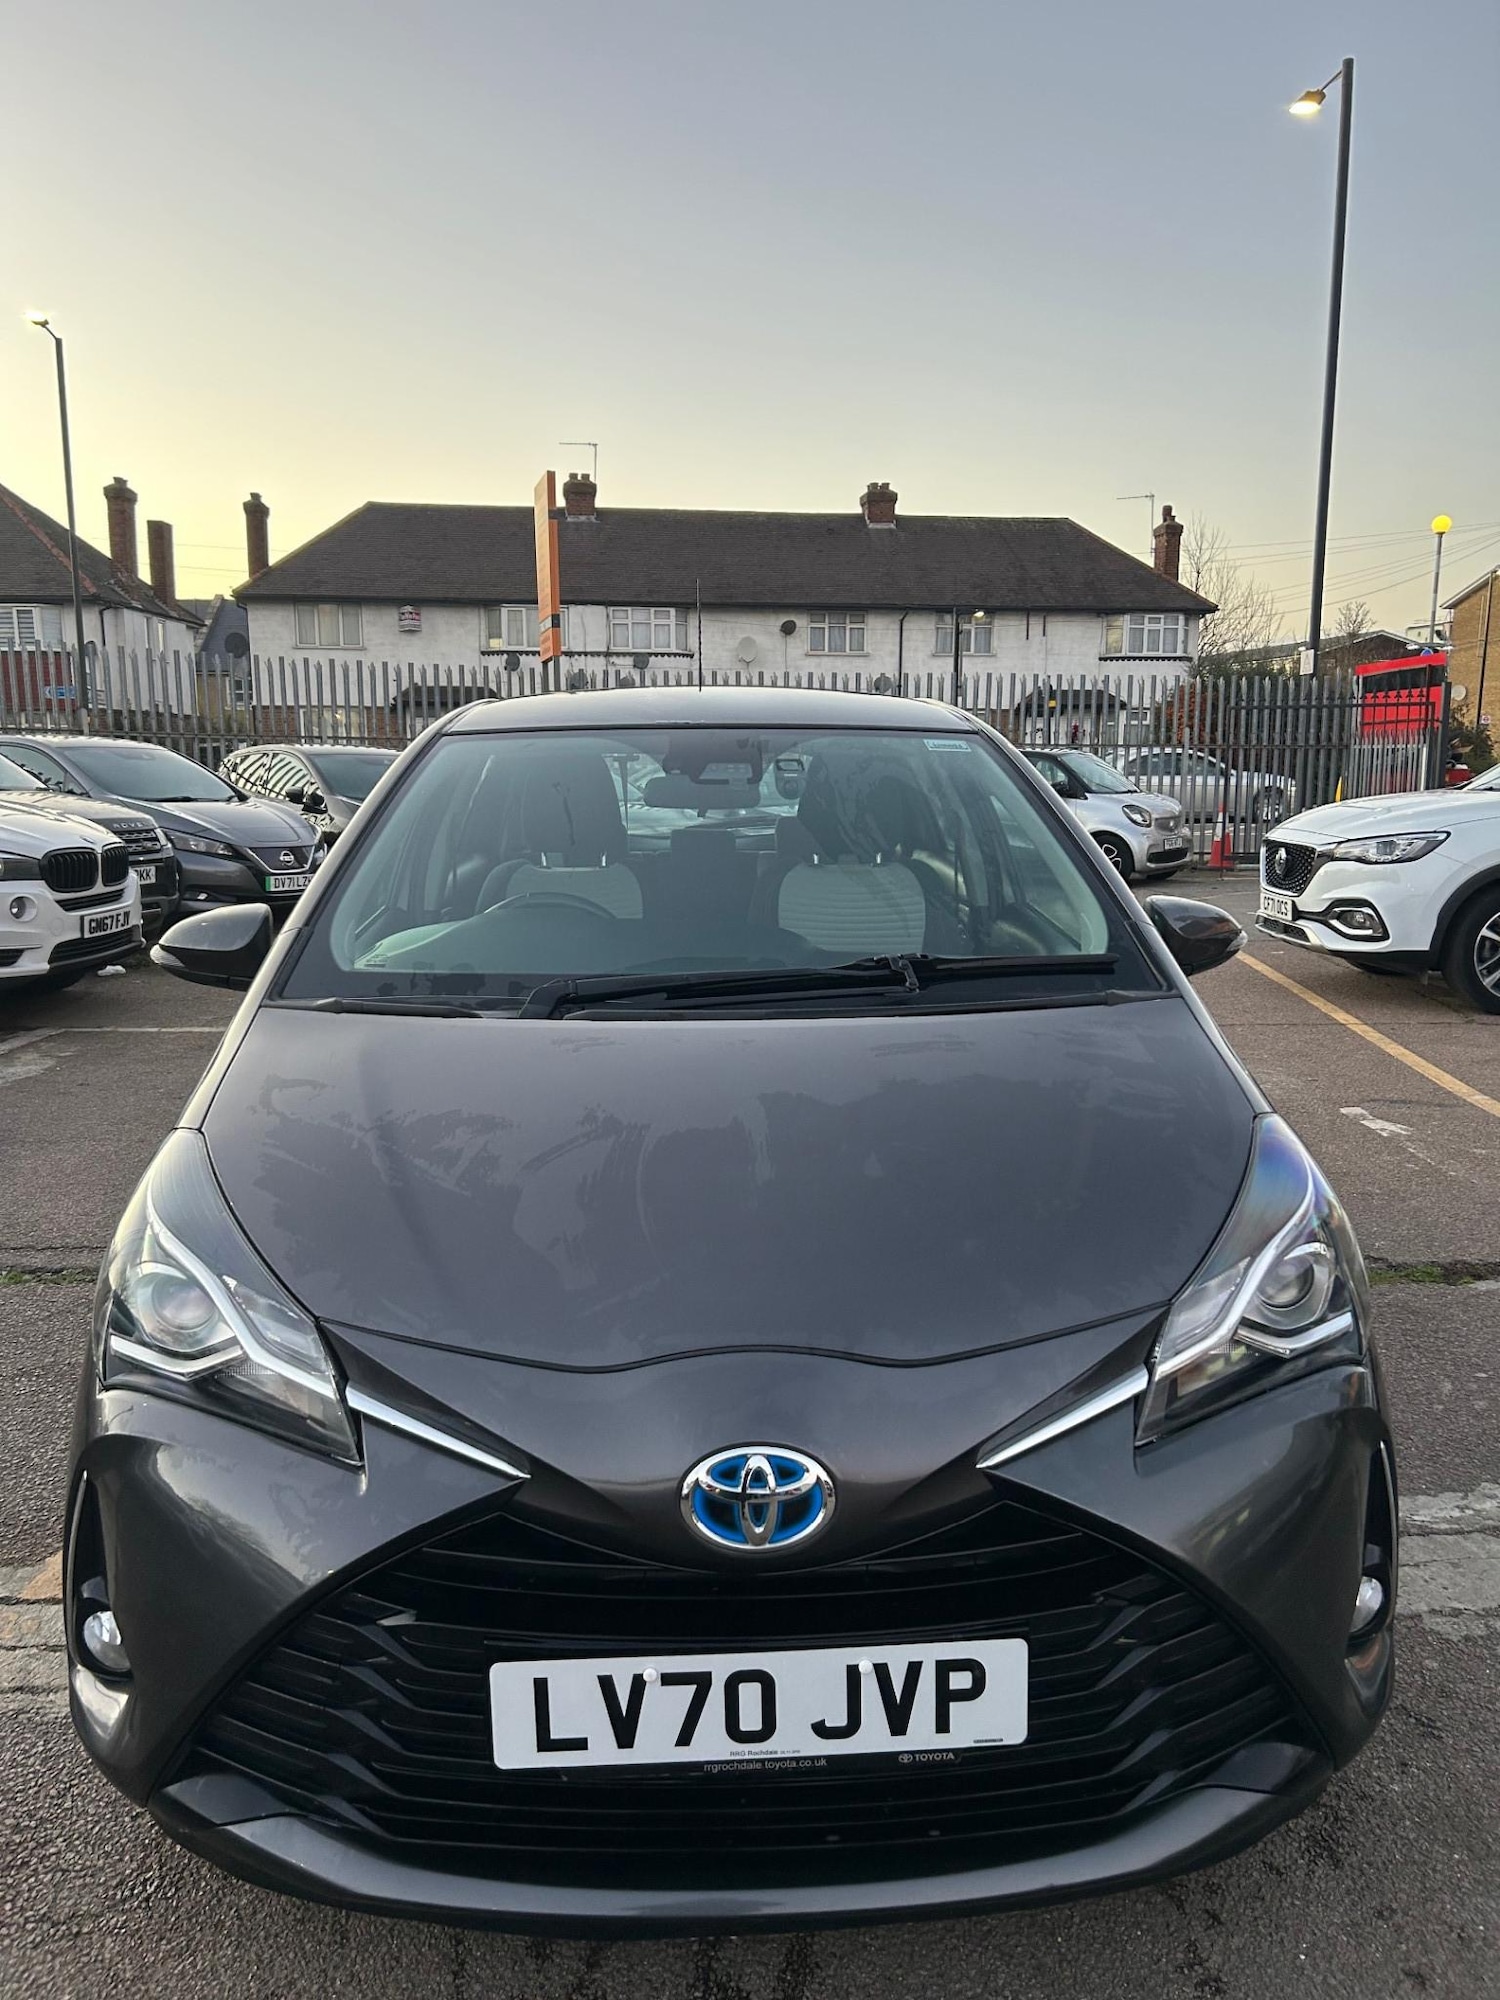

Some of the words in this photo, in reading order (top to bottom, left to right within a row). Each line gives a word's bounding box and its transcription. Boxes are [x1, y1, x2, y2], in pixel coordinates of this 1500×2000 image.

[115, 911, 131, 929] FJY
[533, 1668, 777, 1753] LV70
[810, 1657, 987, 1741] JVP
[914, 1751, 955, 1762] TOYOTA
